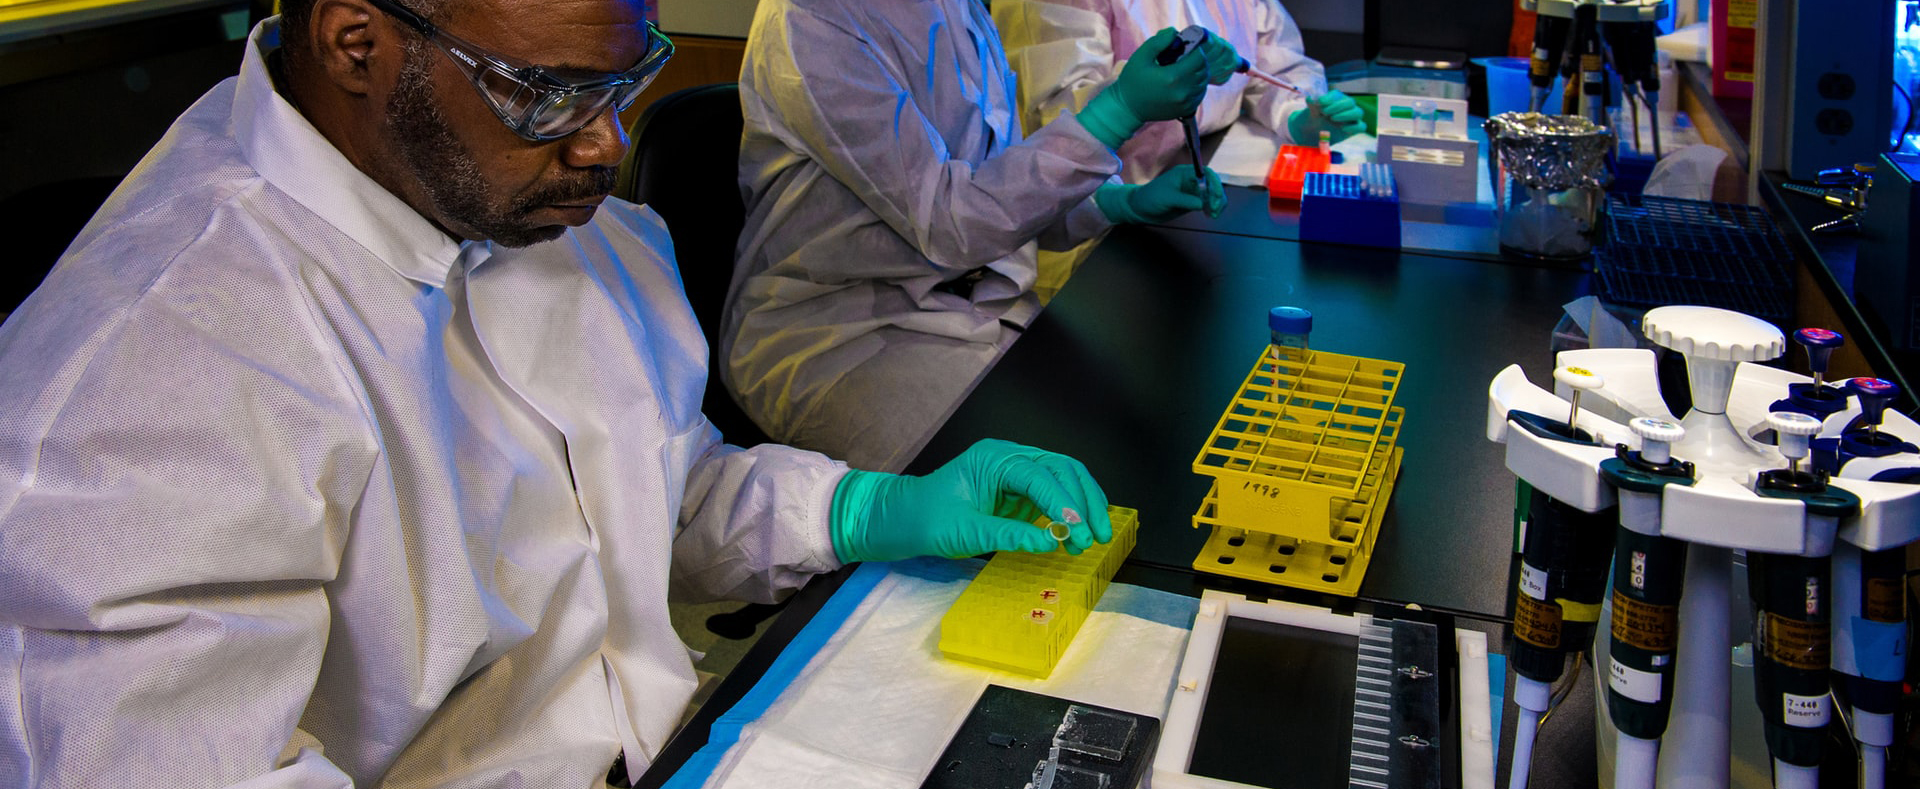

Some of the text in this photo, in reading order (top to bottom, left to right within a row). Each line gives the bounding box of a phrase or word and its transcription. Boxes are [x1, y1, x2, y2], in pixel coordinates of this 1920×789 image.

[1243, 481, 1280, 498] 1998
[1788, 698, 1817, 708] 7-448
[1788, 708, 1820, 717] Reserve
